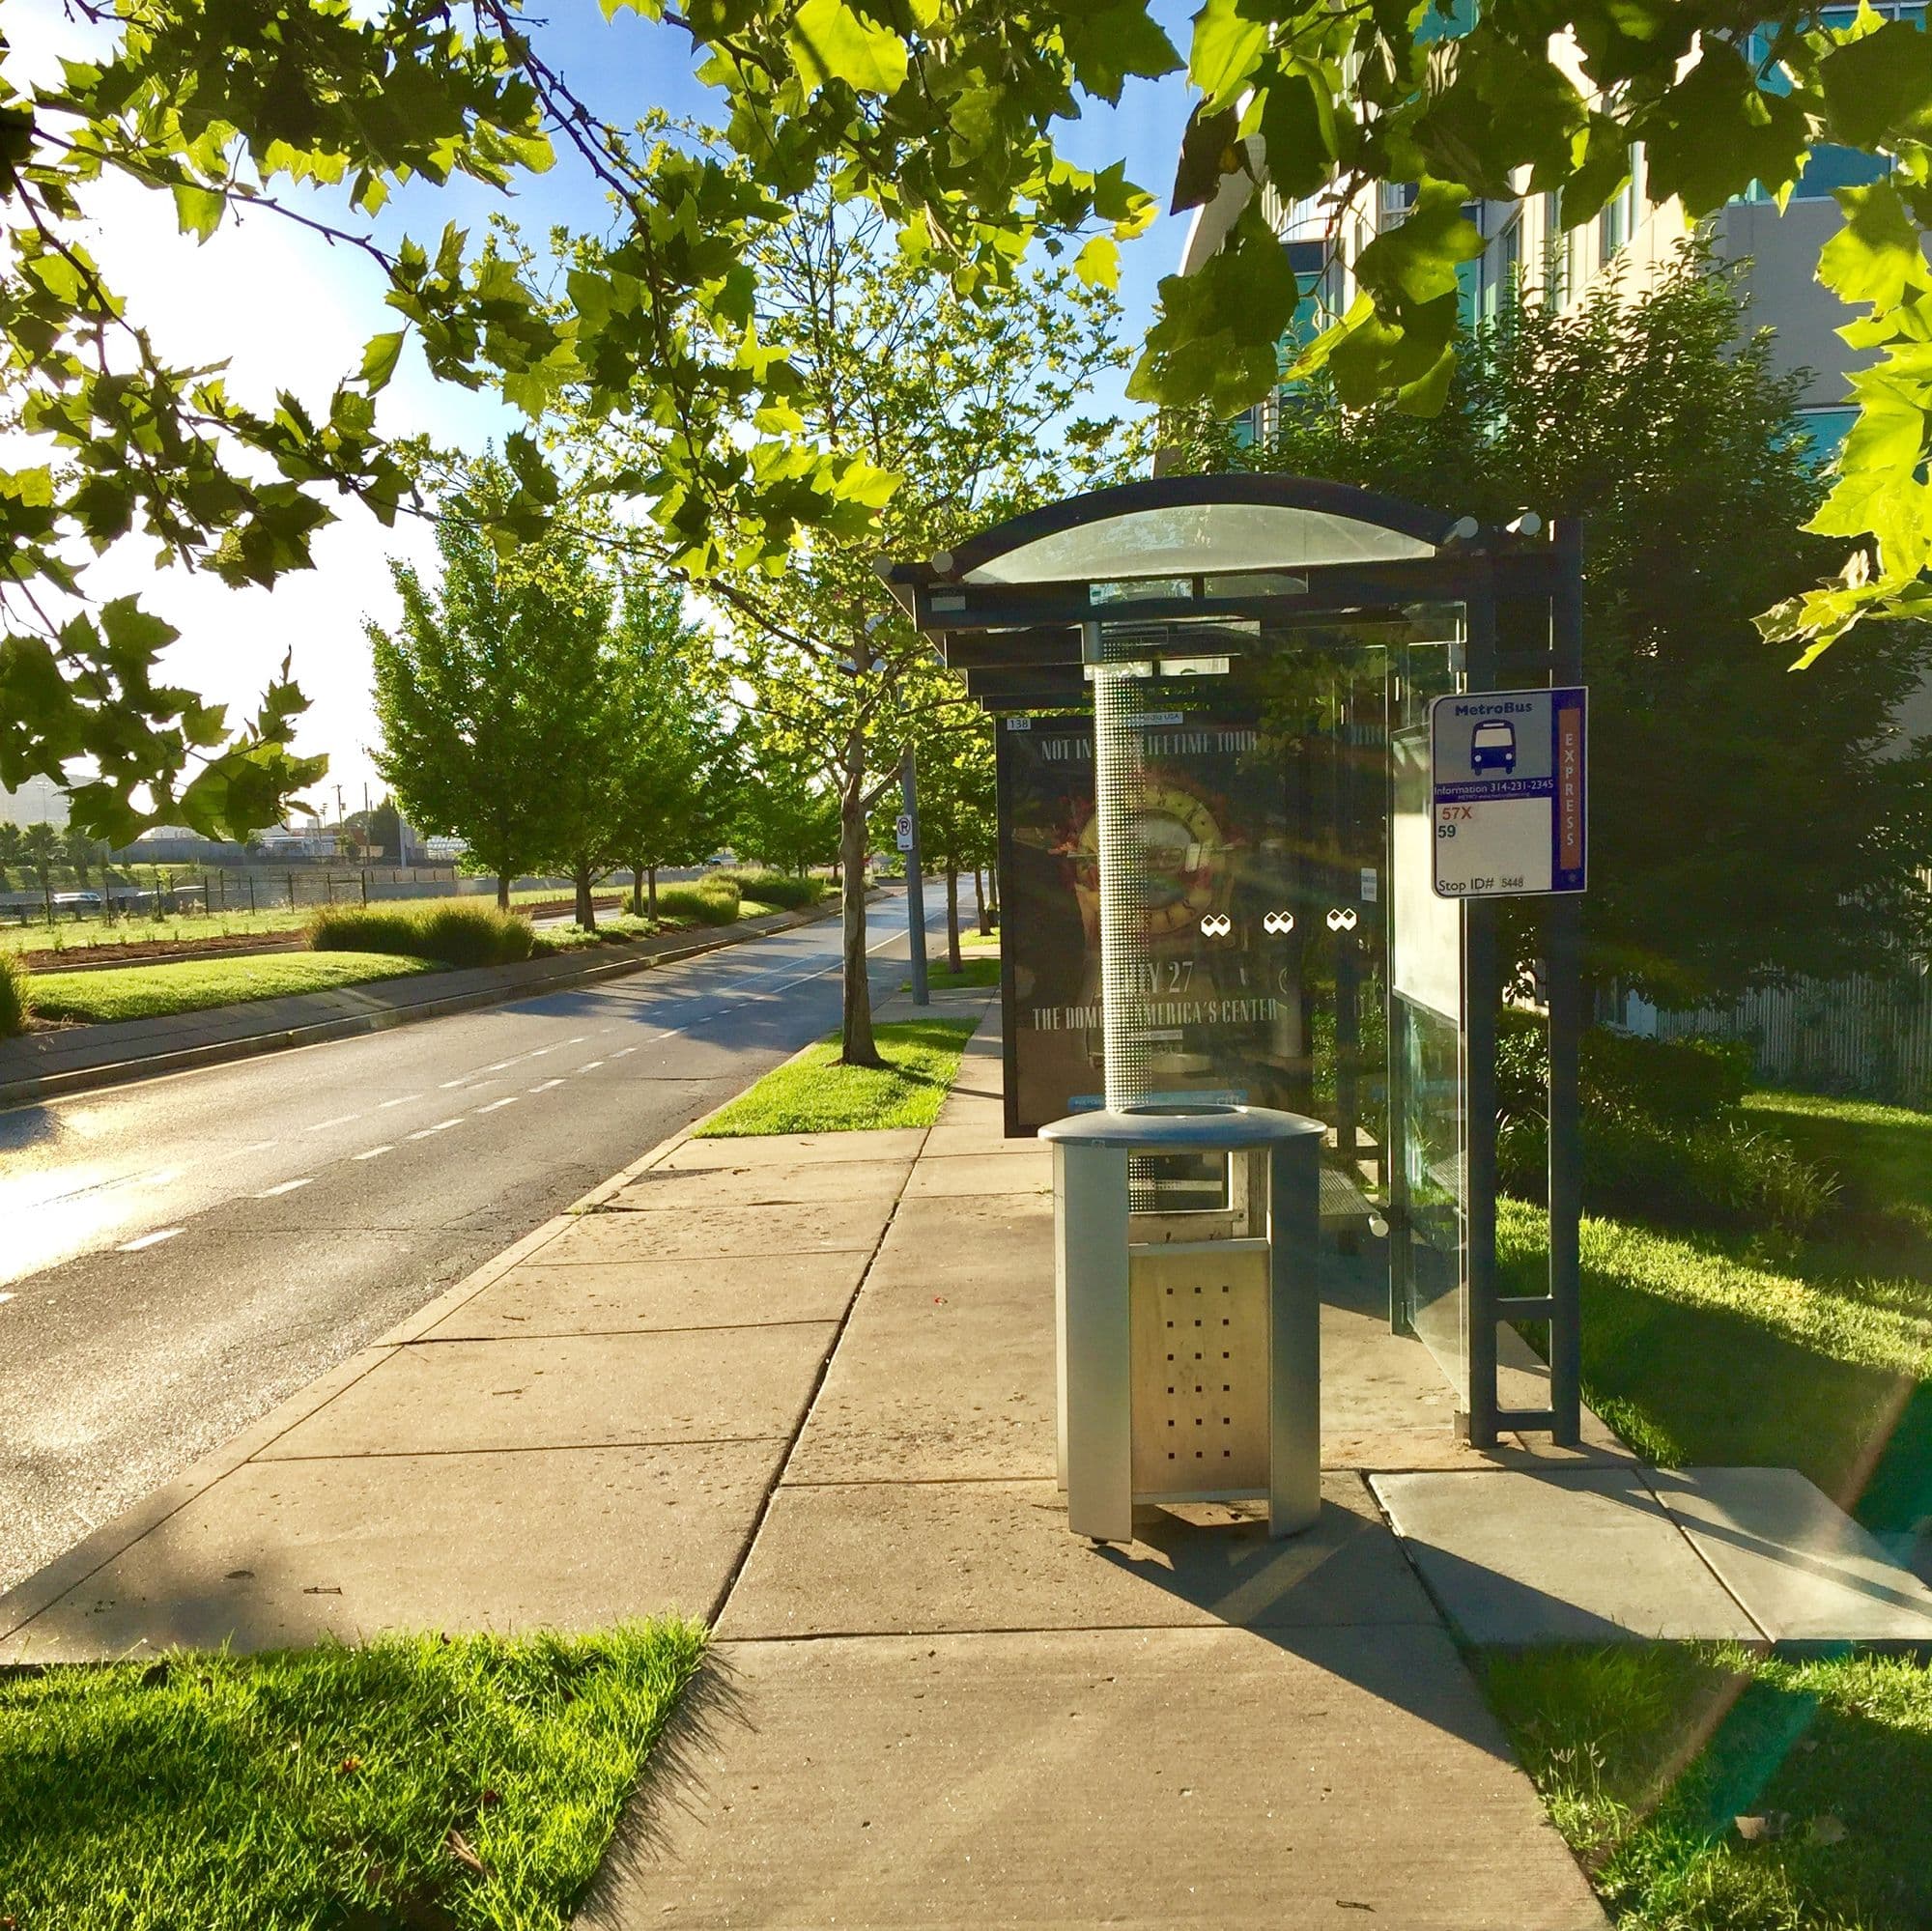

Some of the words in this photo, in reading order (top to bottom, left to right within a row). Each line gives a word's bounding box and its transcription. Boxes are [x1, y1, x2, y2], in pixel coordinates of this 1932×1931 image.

[1455, 702, 1532, 716] MetroBus
[1009, 719, 1029, 728] 138
[1041, 739, 1071, 760] NOT
[1076, 738, 1092, 758] IN
[1215, 731, 1258, 752] TOUR
[1435, 784, 1487, 796] Information
[1491, 780, 1553, 792] 314-231-2345
[1563, 733, 1576, 846] EXPRESS
[1441, 807, 1472, 820] 57X
[1437, 825, 1456, 838] 59
[1438, 880, 1465, 894] Stop
[1470, 877, 1494, 890] ID#
[1501, 877, 1524, 889] 5448
[1169, 961, 1194, 993] 27
[1033, 1008, 1060, 1031] THE
[1222, 998, 1278, 1023] CENTER
